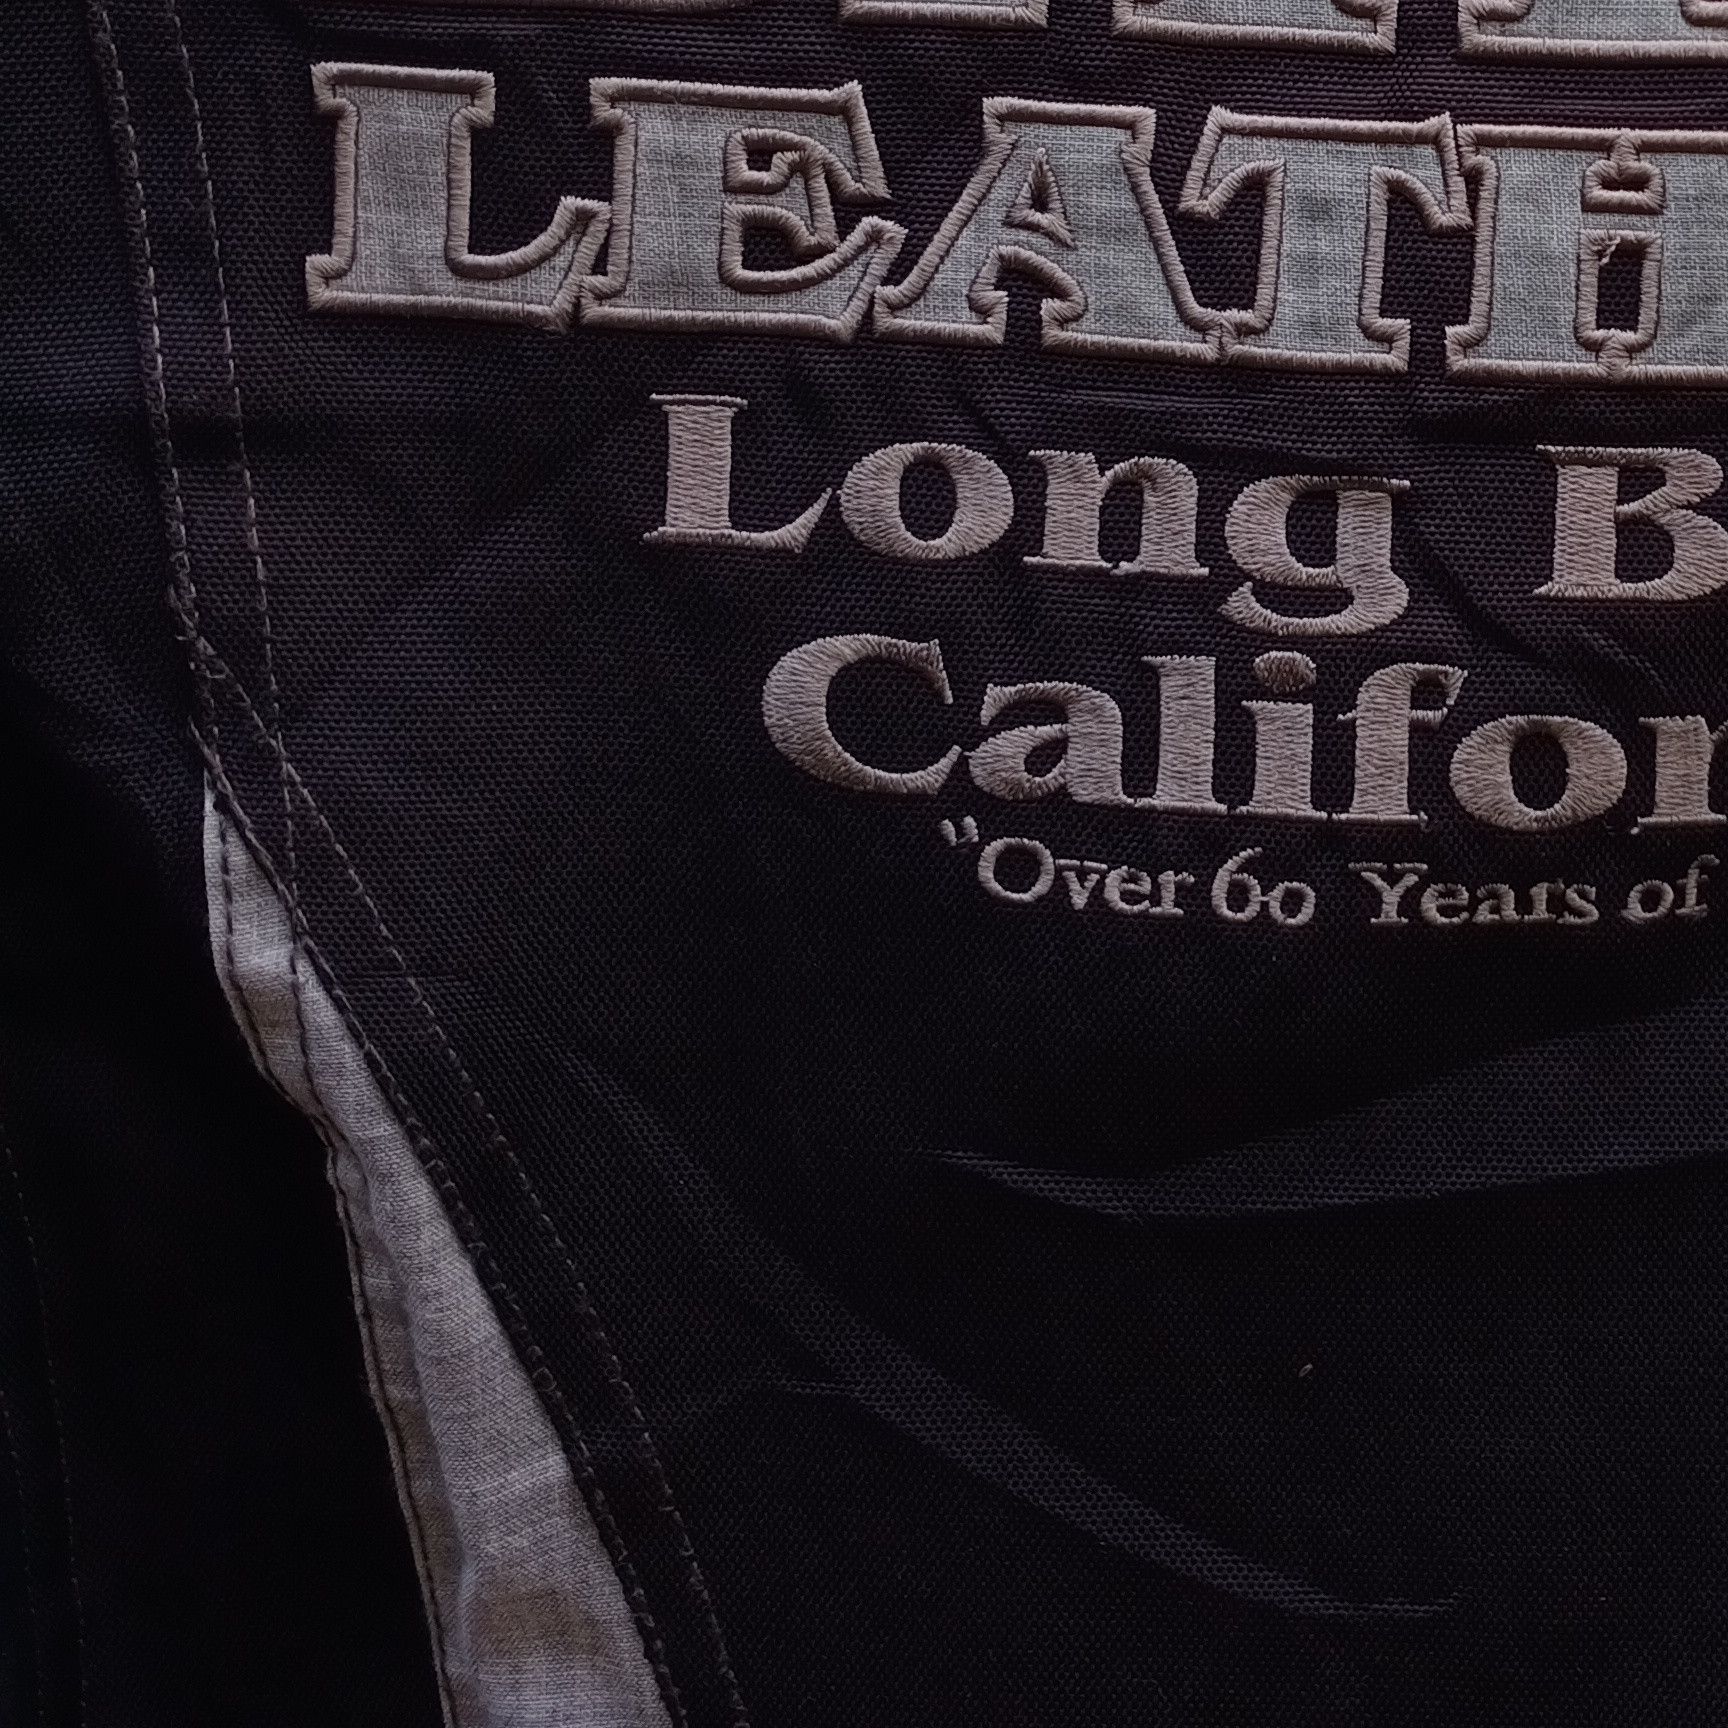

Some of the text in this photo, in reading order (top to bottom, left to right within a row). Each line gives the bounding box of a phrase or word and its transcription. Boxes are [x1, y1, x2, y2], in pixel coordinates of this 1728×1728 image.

[642, 393, 1411, 636] Long
[1211, 846, 1317, 928] 60
[1348, 861, 1600, 927] Years
[1622, 856, 1720, 926] of
